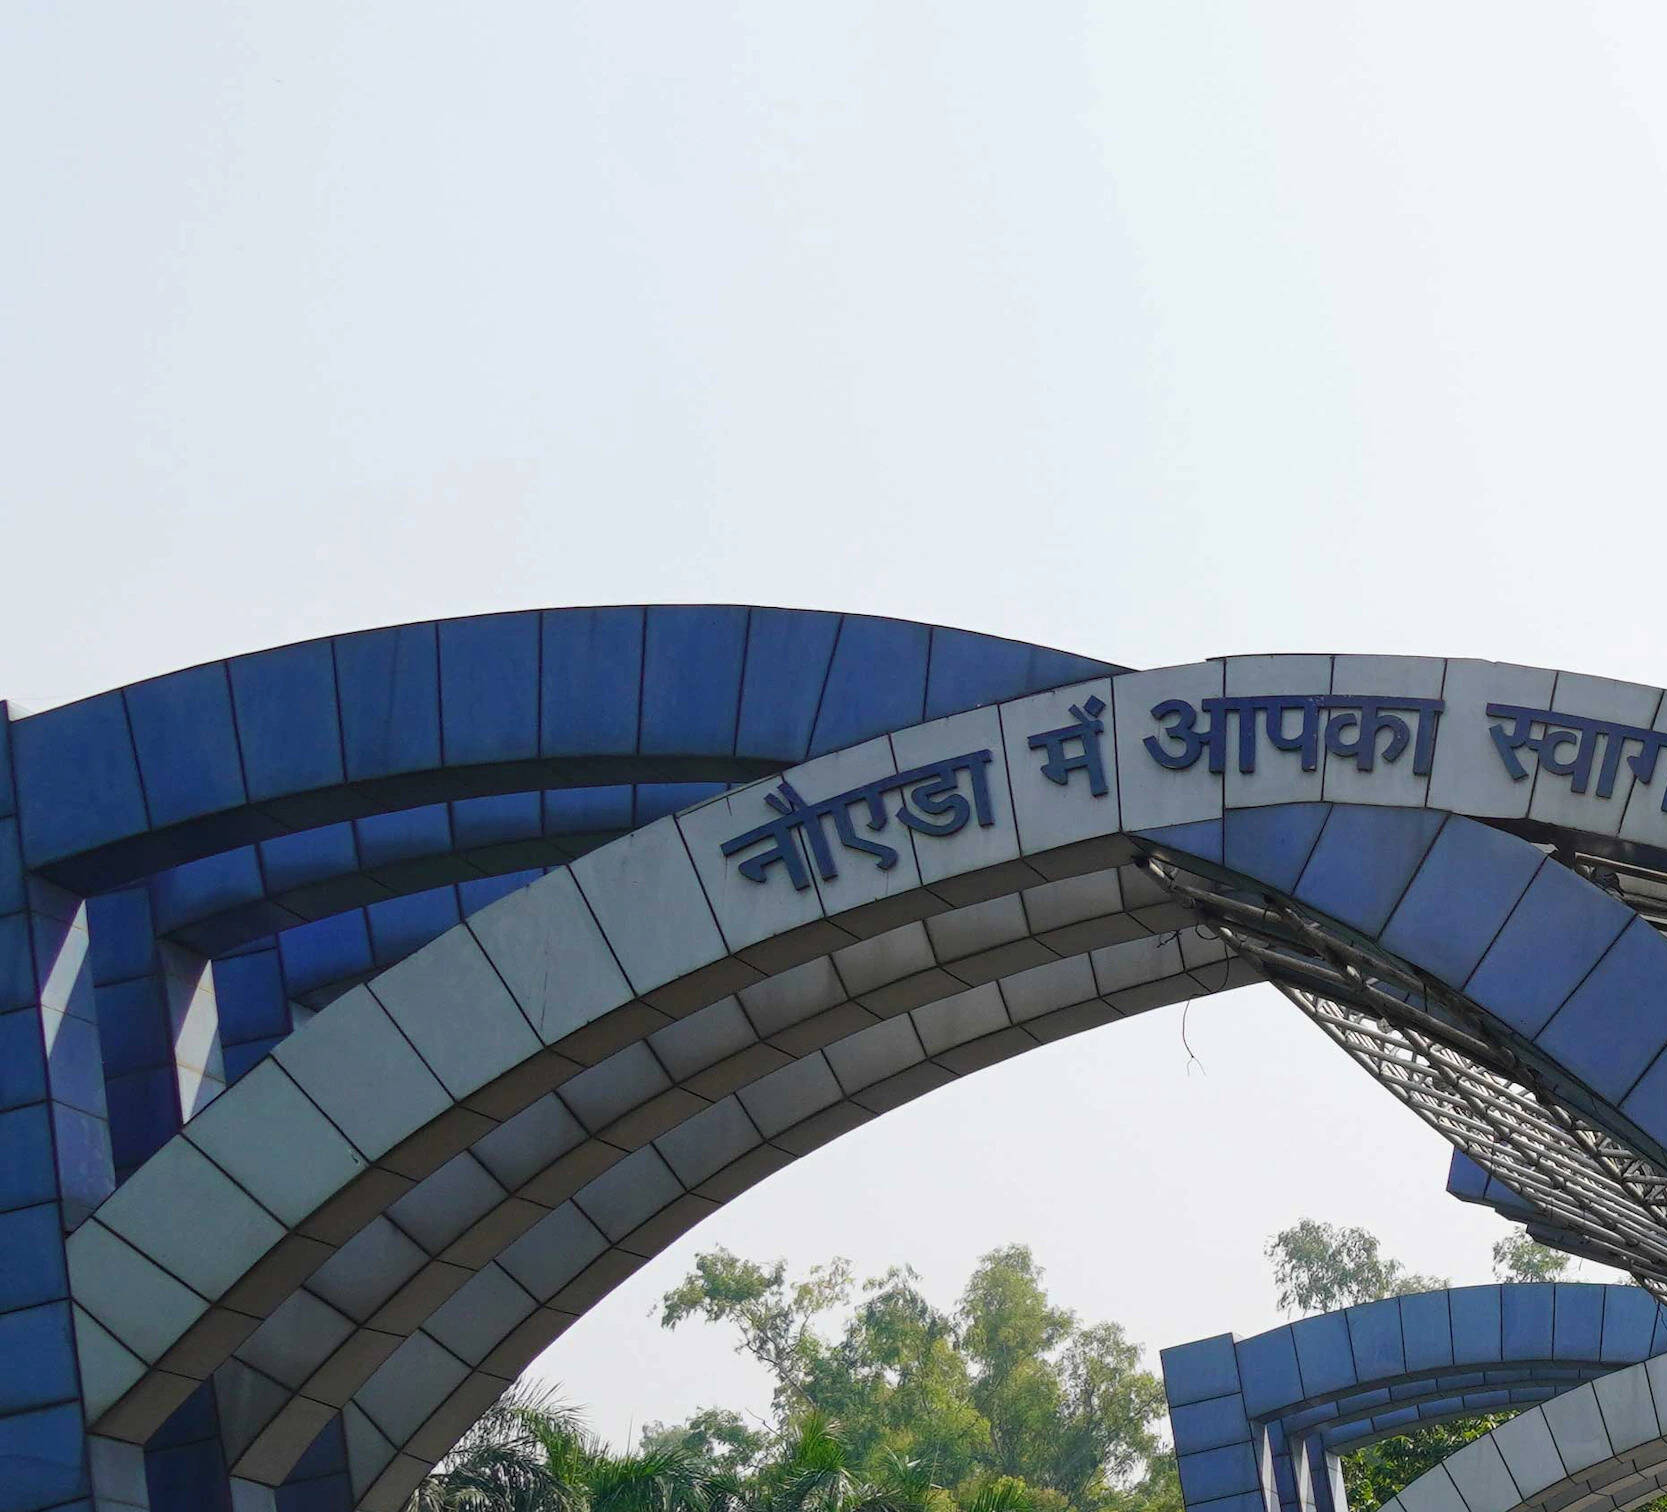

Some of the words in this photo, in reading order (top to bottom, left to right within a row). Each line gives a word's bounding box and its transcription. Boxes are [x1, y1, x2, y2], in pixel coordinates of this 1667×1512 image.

[720, 749, 994, 891] नौएडा
[1027, 694, 1111, 798] में
[1142, 694, 1445, 776] आपका
